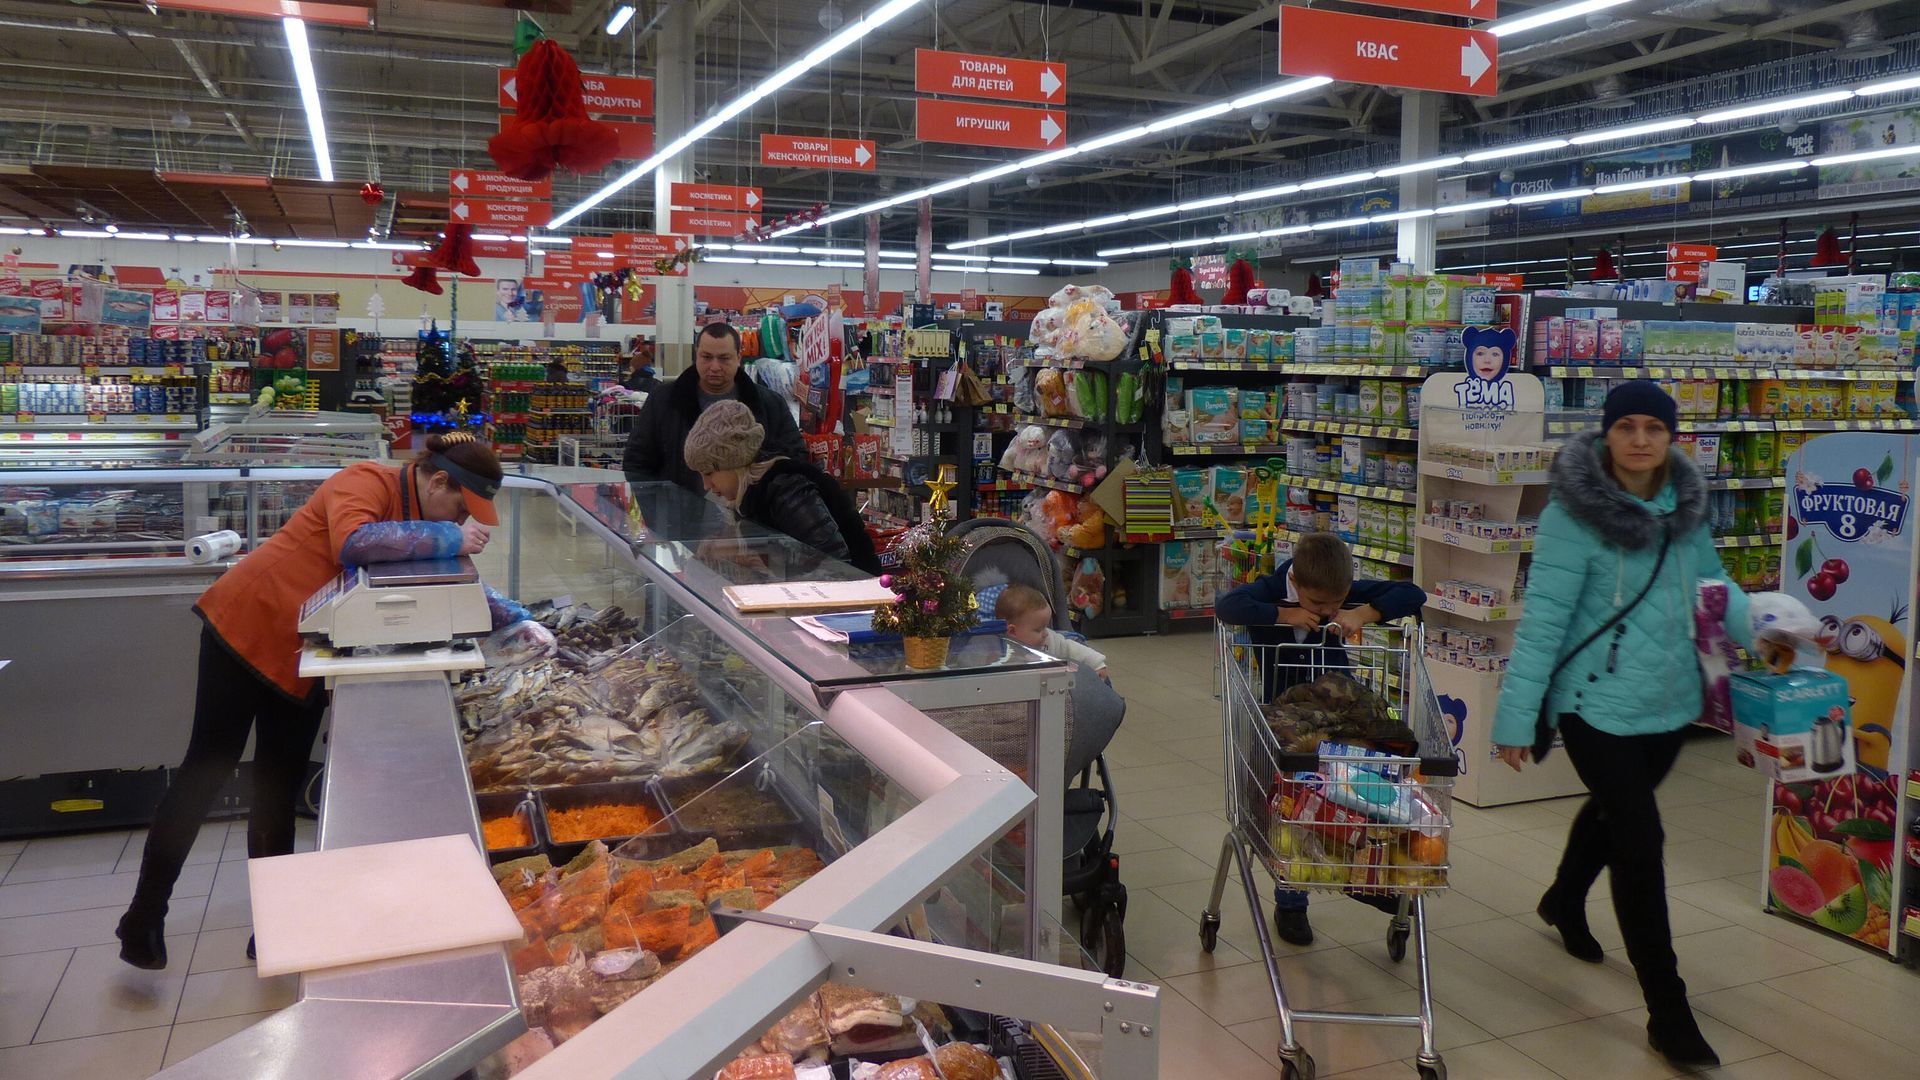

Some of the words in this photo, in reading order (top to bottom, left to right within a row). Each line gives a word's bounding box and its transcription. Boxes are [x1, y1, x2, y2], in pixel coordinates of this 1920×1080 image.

[1356, 40, 1399, 61] КВАС
[959, 59, 1007, 75] ТОВАРЫ
[952, 75, 976, 88] ДЛЯ
[977, 78, 1014, 92] ДЕТЕЙ
[956, 116, 1010, 132] ИГРУШКИ
[792, 141, 828, 151] ТОВАРЫ
[1786, 133, 1814, 149] Apple
[767, 150, 811, 163] ЖЕНСКОЙ
[811, 154, 852, 165] ГИГИЕНЫ
[1793, 145, 1814, 157] Jack
[485, 184, 533, 193] ПРОДУКЦИЯ
[689, 191, 733, 202] КОСМЕТИКА
[487, 203, 529, 213] КОНСЕРВЫ
[491, 214, 525, 222] МЯСНЫЕ
[689, 217, 732, 228] КОСМЕТИКА
[806, 338, 827, 366] MIX!
[1205, 402, 1228, 411] Pampers
[1801, 494, 1901, 522] ФРУКТОВАЯ
[1839, 513, 1857, 537] 8
